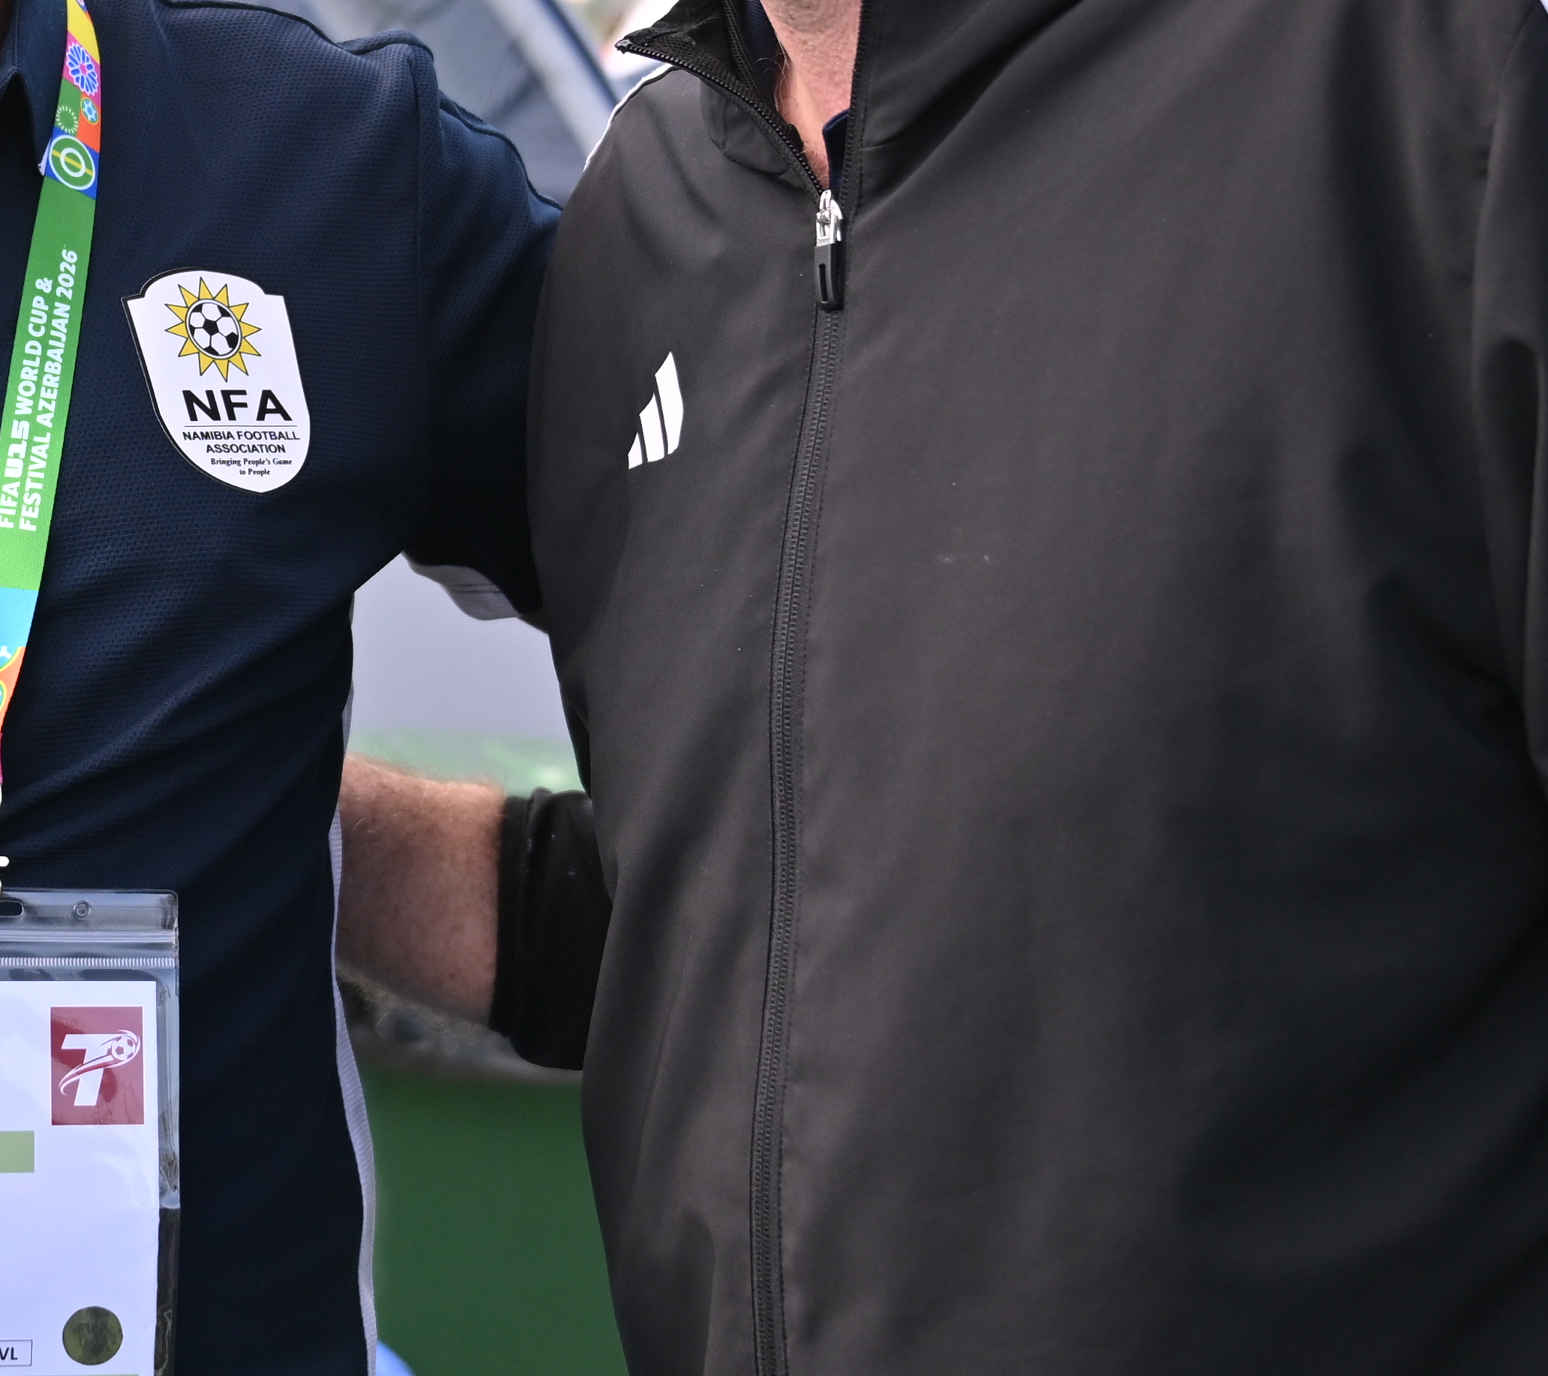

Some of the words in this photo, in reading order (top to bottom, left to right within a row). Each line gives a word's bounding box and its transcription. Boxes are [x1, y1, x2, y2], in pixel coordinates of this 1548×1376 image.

[36, 278, 52, 293] &
[28, 296, 48, 337] CUP
[15, 341, 42, 415] WORLD
[19, 432, 51, 531] FESTIVAL
[36, 302, 70, 428] AZERBAIJAN
[56, 249, 77, 300] 2026
[182, 389, 292, 421] NFA
[182, 430, 235, 441] NAMIBIA
[237, 430, 300, 441] FOOTBALL
[4, 419, 30, 478] U15
[206, 443, 286, 453] ASSOCIATION
[210, 457, 241, 467] Bringing
[243, 457, 271, 467] People's
[248, 467, 270, 477] People
